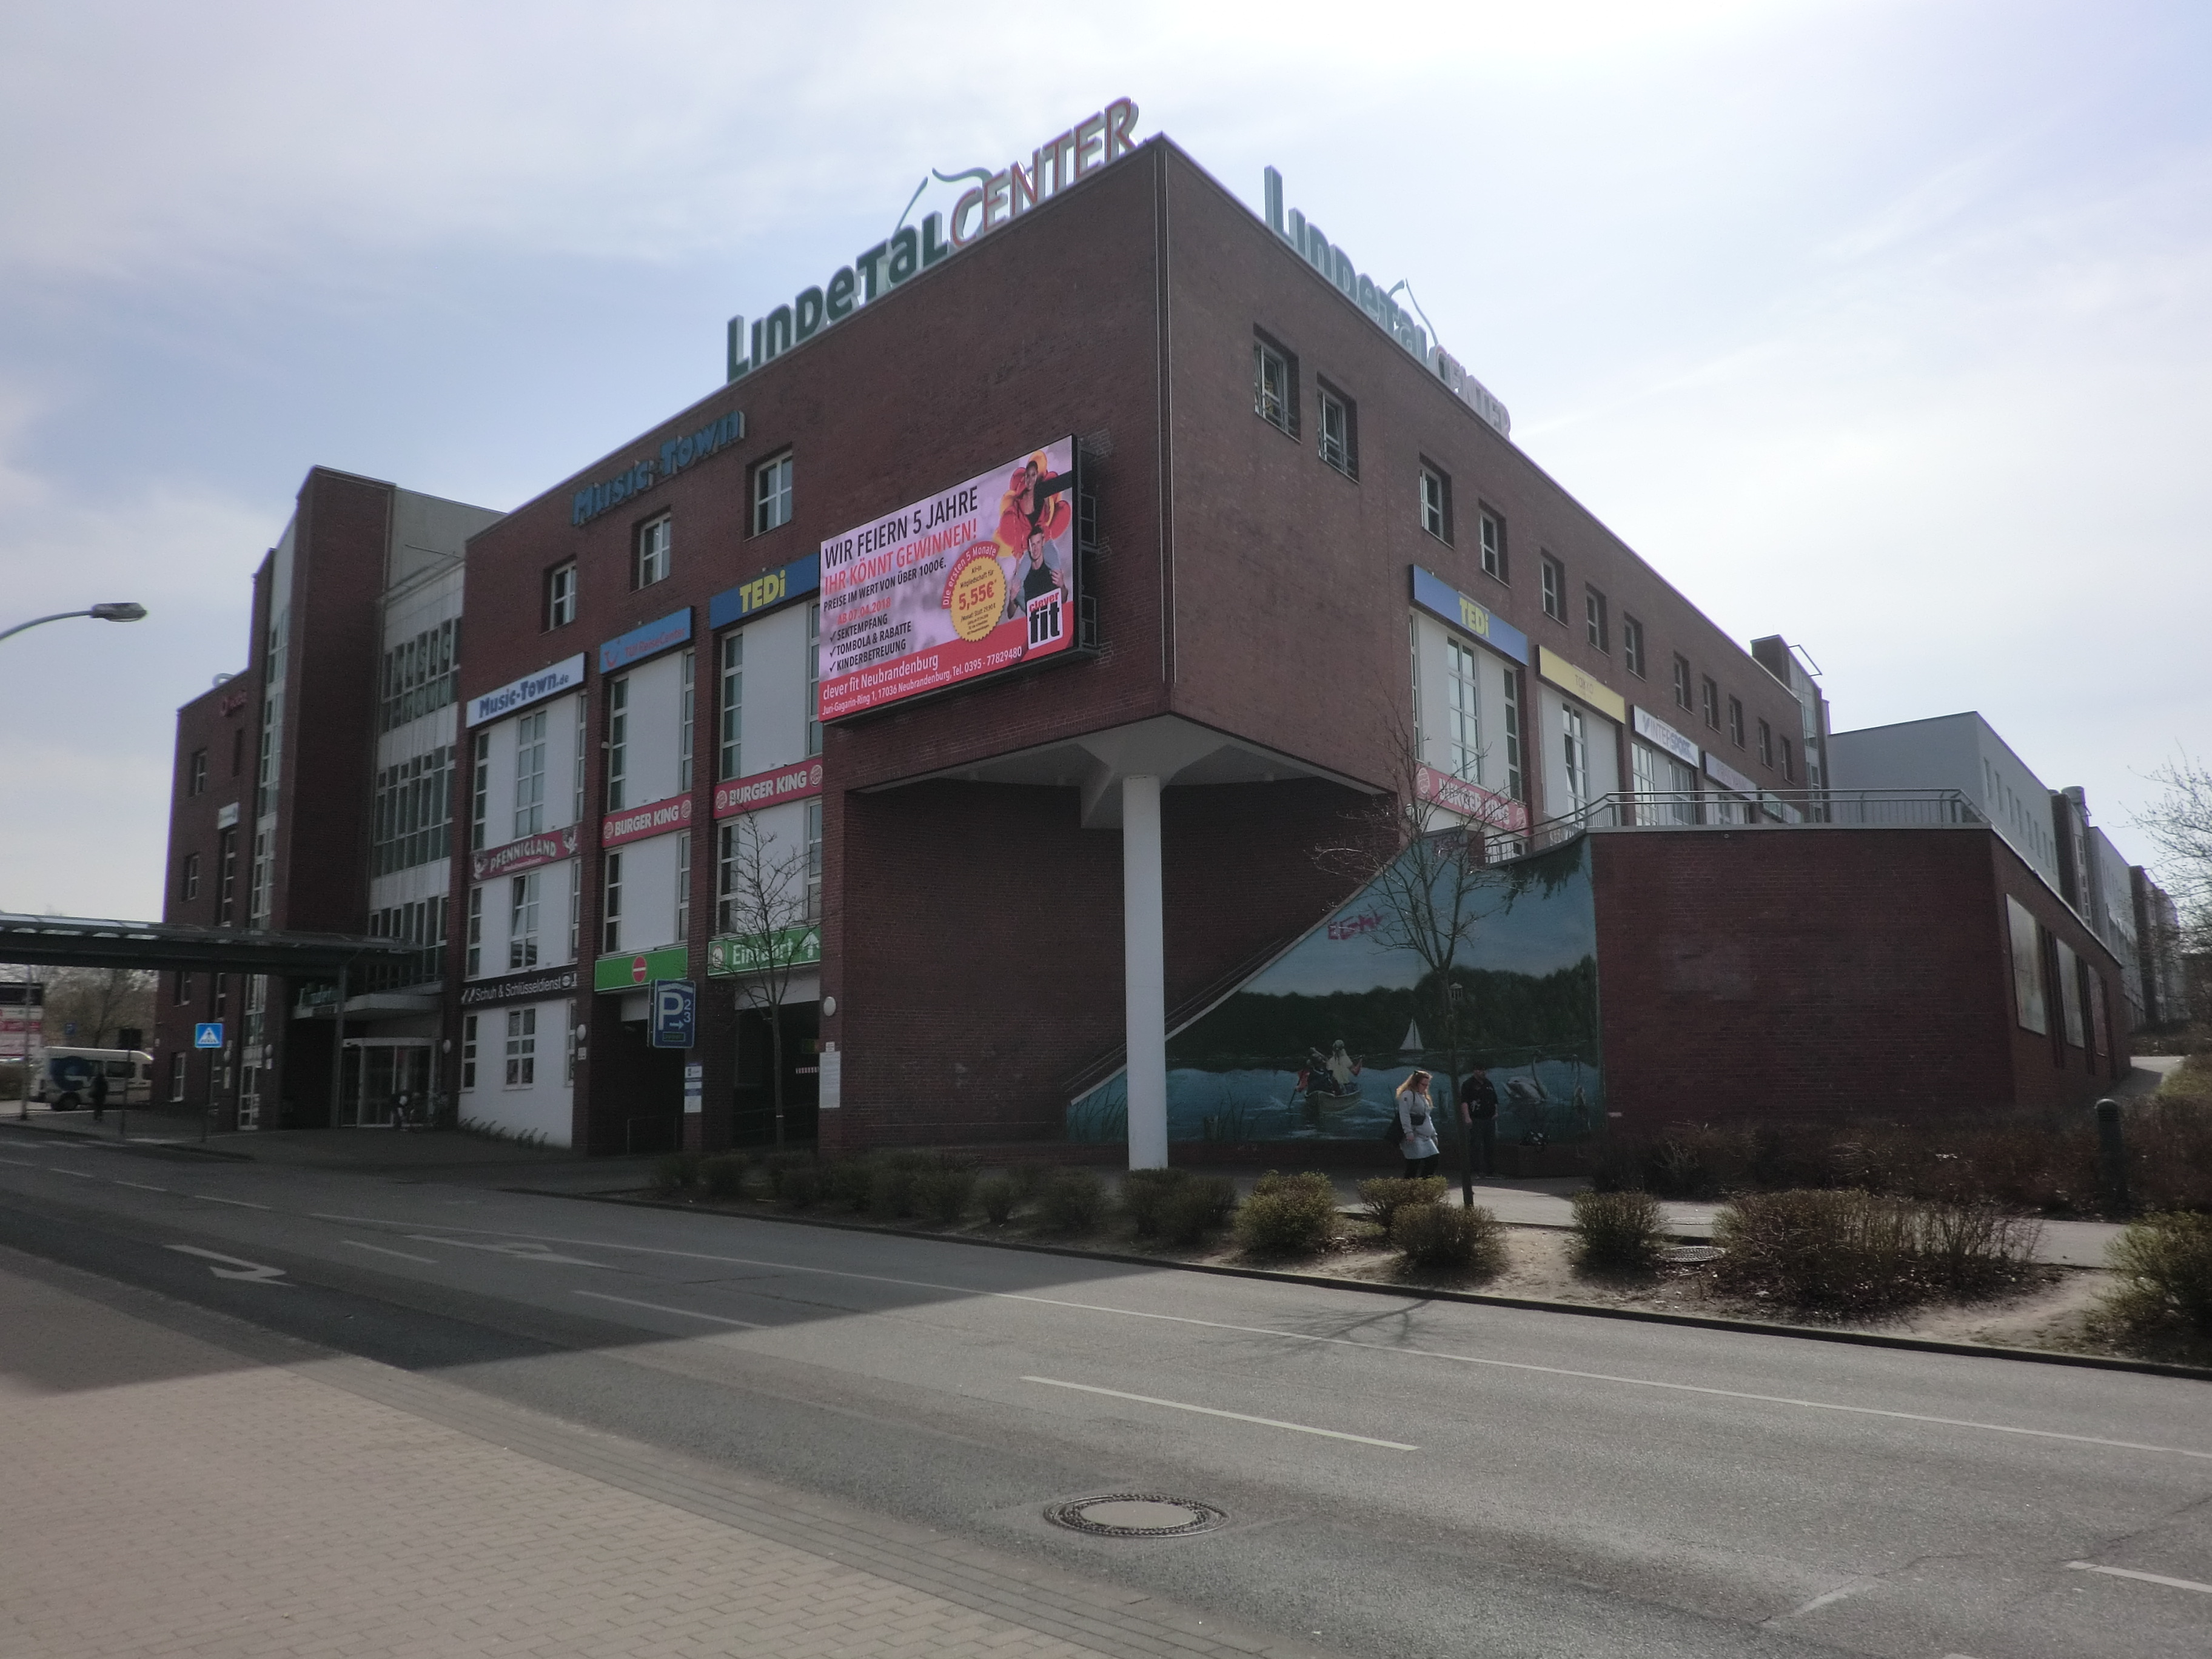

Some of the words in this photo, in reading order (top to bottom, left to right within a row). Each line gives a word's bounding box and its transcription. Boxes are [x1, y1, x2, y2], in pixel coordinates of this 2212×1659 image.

[825, 538, 853, 569] WIR
[857, 515, 908, 557] FEIERN
[913, 509, 922, 534] 5
[926, 486, 978, 529] JAHRE
[825, 572, 846, 596] IHR
[850, 551, 893, 586] KÖNNT
[896, 518, 978, 566] GEWINNEN!
[948, 559, 966, 588] ersten
[965, 551, 971, 561] 5
[971, 545, 997, 557] Monate
[739, 569, 786, 614] TEDi
[823, 594, 846, 612] PREISE
[848, 591, 857, 603] IM
[859, 583, 880, 598] WERT
[880, 577, 896, 592] VON
[897, 567, 917, 585] ÜBER
[919, 557, 947, 577] 1000€.
[1029, 590, 1059, 612] clever
[837, 612, 847, 625] AB
[848, 597, 891, 622] 07.04.2018
[837, 614, 888, 641] SEKTEMPFANG
[1029, 602, 1060, 644] fit
[1458, 597, 1489, 638] TEDi
[837, 631, 871, 655] TOMBOLA
[872, 632, 878, 644] &
[879, 621, 911, 642] RABATTE
[837, 638, 907, 671] KINDERBETREUUNG
[479, 673, 569, 718] Music-Town.de
[822, 694, 871, 716] Juri-Gagarin-Ring
[871, 691, 877, 702] 1,
[878, 684, 897, 699] 17036
[898, 669, 952, 694] Neubrandenburg,
[953, 665, 964, 677] Tel.
[964, 660, 982, 674] 0395
[987, 646, 1022, 666] 77829480
[823, 682, 848, 700] clever
[850, 677, 859, 691] fit
[861, 654, 939, 688] Neubrandenburg
[728, 780, 774, 806] BURGER
[776, 771, 807, 796] KING
[614, 813, 651, 836] BURGER
[654, 805, 679, 826] KING
[490, 839, 557, 873] PFENNIGLAND
[475, 987, 497, 1002] Schuh
[497, 985, 504, 998] &
[505, 976, 561, 997] Schlüsseldienst
[684, 999, 691, 1011] 2
[658, 991, 684, 1031] P
[683, 1011, 691, 1023] 3
